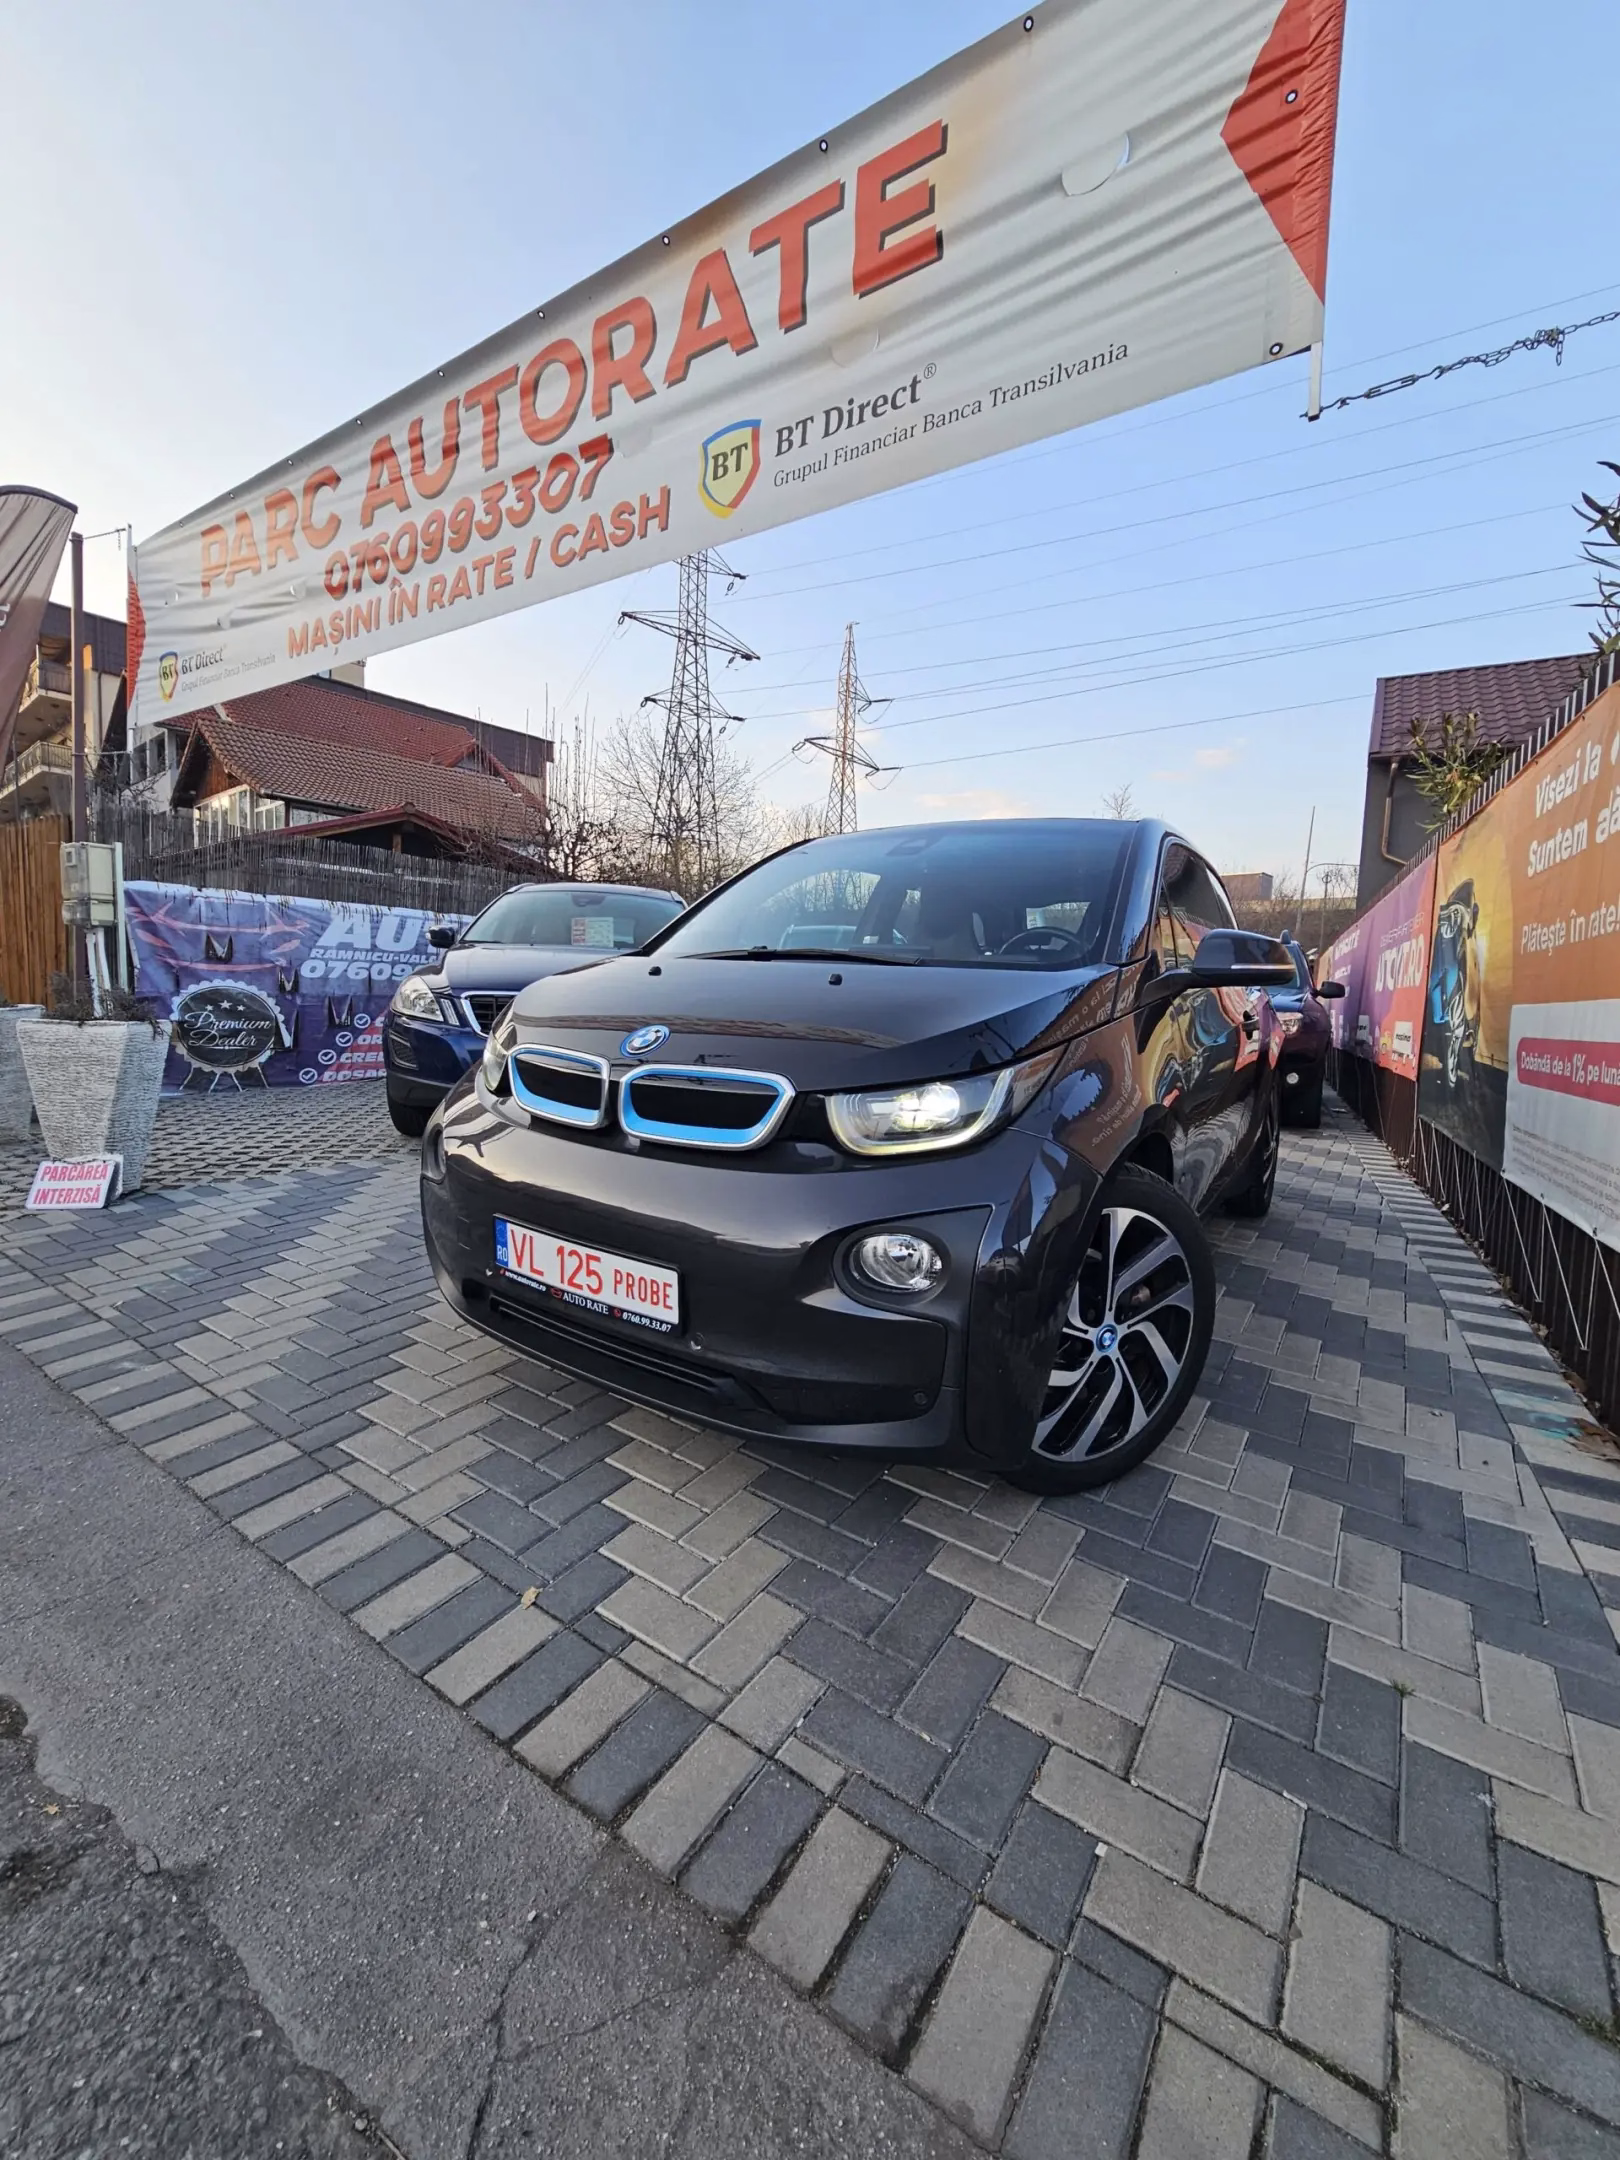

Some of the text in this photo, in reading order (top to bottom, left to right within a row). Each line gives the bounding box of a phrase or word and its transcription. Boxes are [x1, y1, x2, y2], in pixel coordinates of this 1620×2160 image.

[200, 119, 948, 598] PARC AUTORATE
[773, 342, 1129, 488] Grupul Financiar Banca Transilvania
[774, 415, 815, 457] BT
[712, 442, 749, 481] BT
[324, 433, 614, 601] 0760993307
[287, 484, 671, 656] MAȘINI ÎN RATE / CASH
[161, 649, 223, 681] BT BT Direct
[1535, 747, 1581, 818] Visezi
[1583, 740, 1601, 785] la
[1527, 818, 1588, 878] Suntem
[1569, 908, 1585, 943] în
[300, 959, 420, 981] 07609
[184, 1011, 272, 1030] Premium
[188, 1029, 258, 1047] Dealer
[1521, 1051, 1551, 1073] Dobândă
[1552, 1056, 1563, 1075] de
[1564, 1056, 1571, 1076] la
[1572, 1053, 1586, 1083] 1%
[1587, 1064, 1599, 1086] pe
[40, 1163, 109, 1181] PARCAREA
[497, 1244, 508, 1262] RO
[510, 1229, 673, 1310] VL 125 PROBE
[563, 1292, 586, 1307] AUTO
[586, 1299, 609, 1315] RATE
[622, 1311, 672, 1333] 0760.99.33.07
